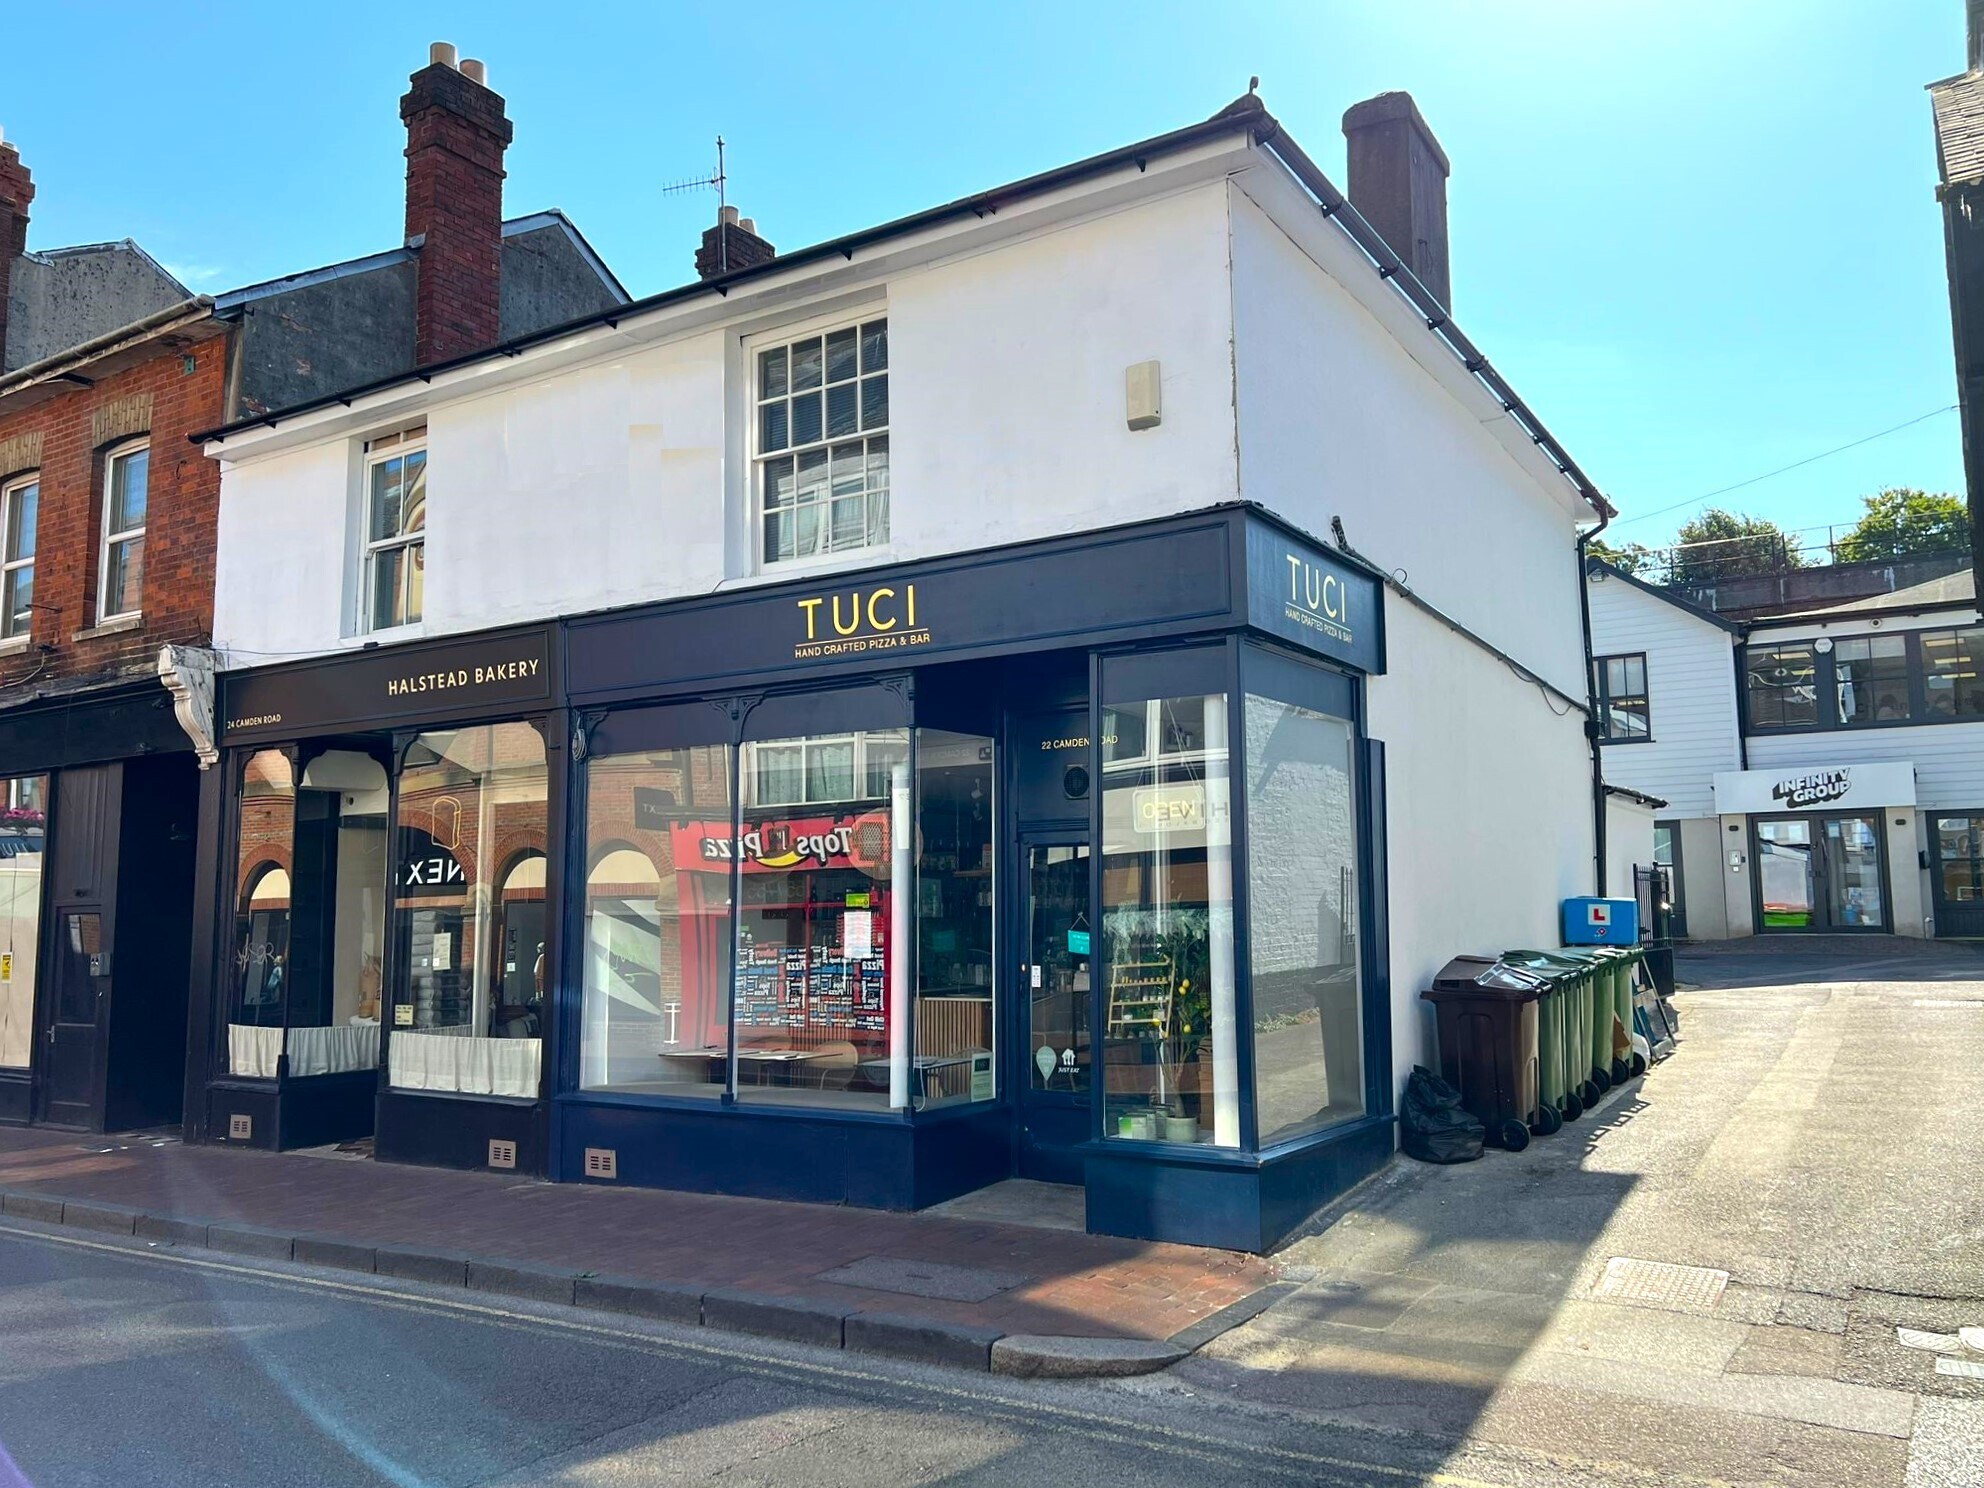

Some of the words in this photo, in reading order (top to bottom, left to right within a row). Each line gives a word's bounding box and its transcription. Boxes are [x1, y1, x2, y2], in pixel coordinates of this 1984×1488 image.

[1286, 553, 1346, 623] TUCI
[797, 584, 916, 639] TUCI
[1285, 607, 1300, 622] HAND
[1301, 613, 1324, 632] CRAFTED
[1324, 624, 1338, 638] PIZZA
[1343, 631, 1352, 644] BAR
[795, 646, 821, 659] HAND
[823, 642, 867, 656] CRAFTED
[869, 637, 897, 650] PIZZA
[900, 636, 907, 646] &
[910, 633, 930, 645] BAR
[388, 670, 468, 696] HALSTEAD
[475, 659, 539, 684] BAKERY
[227, 720, 235, 730] 24
[235, 716, 263, 728] CAMDEN
[263, 713, 282, 724] ROAD
[1041, 740, 1052, 750] 22
[1053, 737, 1090, 749] CAMDEN
[1775, 768, 1851, 796] INFINITY
[1790, 780, 1851, 805] GROUP
[1142, 799, 1196, 819] OPEN
[1593, 908, 1605, 921] L
